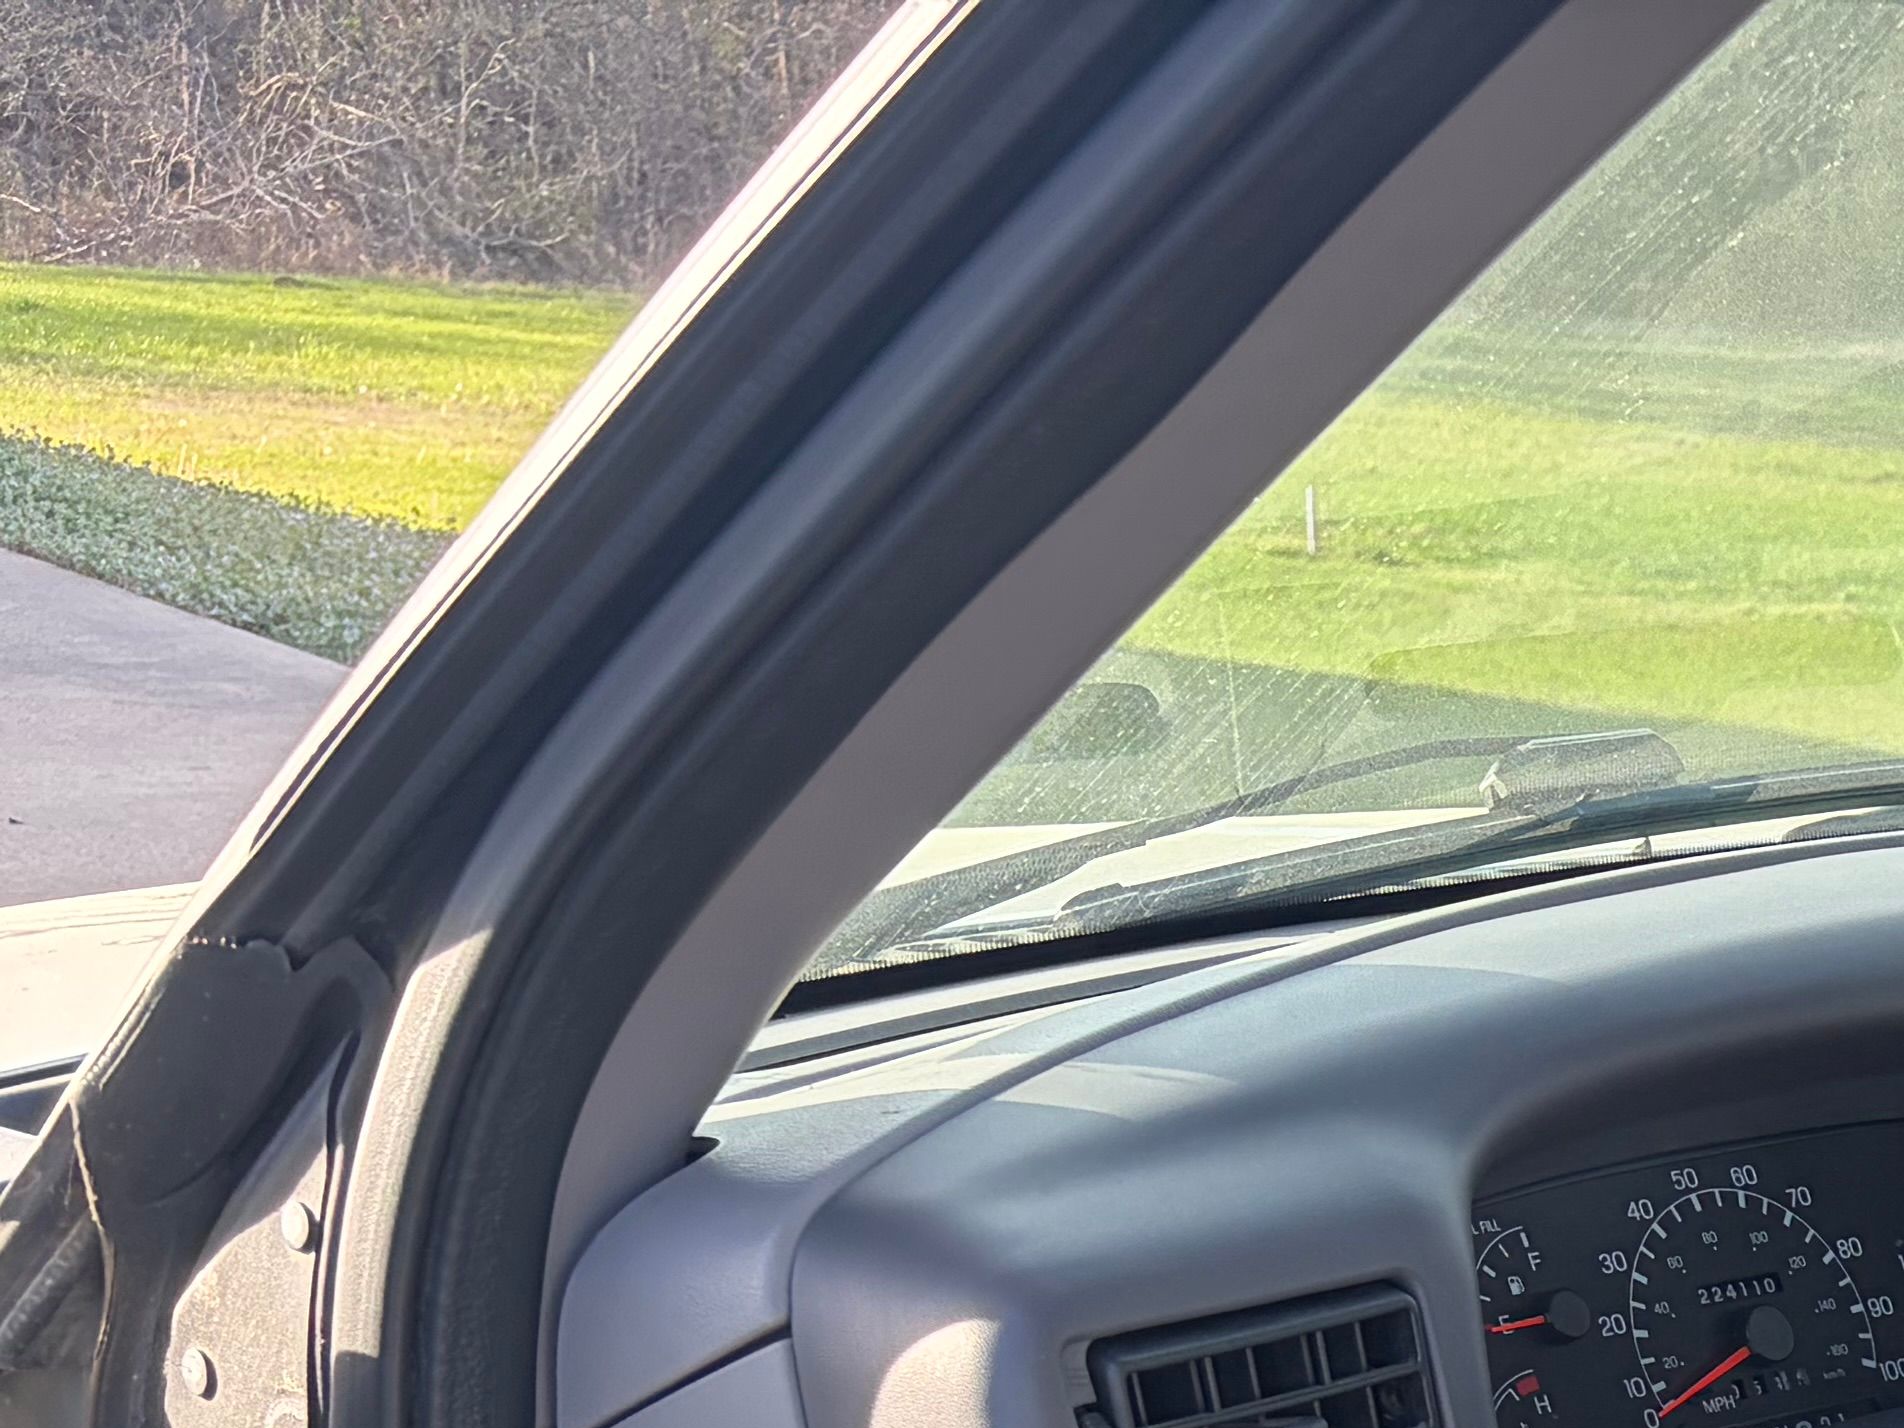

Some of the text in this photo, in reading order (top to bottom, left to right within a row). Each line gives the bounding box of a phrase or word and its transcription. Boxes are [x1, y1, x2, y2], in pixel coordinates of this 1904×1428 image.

[1670, 1168, 1699, 1190] 50
[1729, 1164, 1758, 1187] 60
[1784, 1186, 1812, 1208] 70
[1627, 1199, 1654, 1221] 40
[1749, 1230, 1769, 1244] 100
[1836, 1237, 1863, 1259] 80
[1527, 1251, 1541, 1271] F
[1598, 1250, 1628, 1274] 30
[1788, 1255, 1806, 1269] 120
[1698, 1277, 1776, 1304] 224110
[1654, 1301, 1670, 1315] 40
[1817, 1297, 1837, 1312] 140
[1867, 1295, 1894, 1318] 90
[1598, 1313, 1627, 1337] 20
[1662, 1355, 1678, 1369] 20
[1623, 1377, 1646, 1398] 10
[1533, 1394, 1552, 1414] H
[1702, 1394, 1737, 1414] MPH
